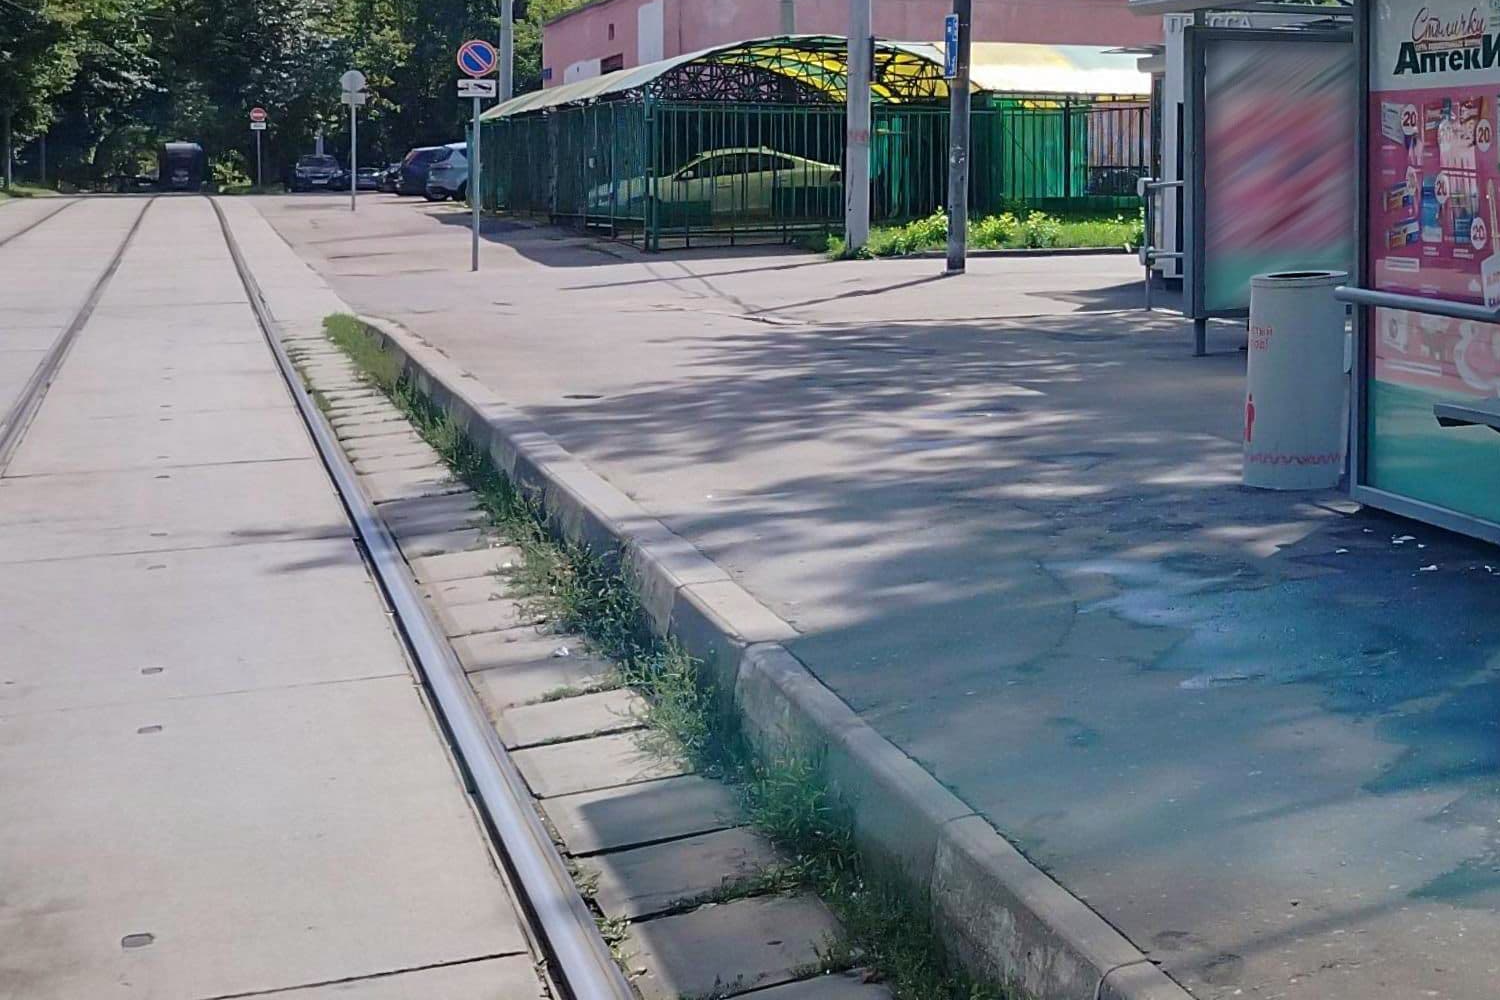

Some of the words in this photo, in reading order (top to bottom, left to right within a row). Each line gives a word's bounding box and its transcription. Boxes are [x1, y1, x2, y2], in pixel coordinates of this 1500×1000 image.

[1168, 15, 1253, 33] ПРССА
[1402, 111, 1417, 128] 20
[1478, 127, 1490, 144] 20
